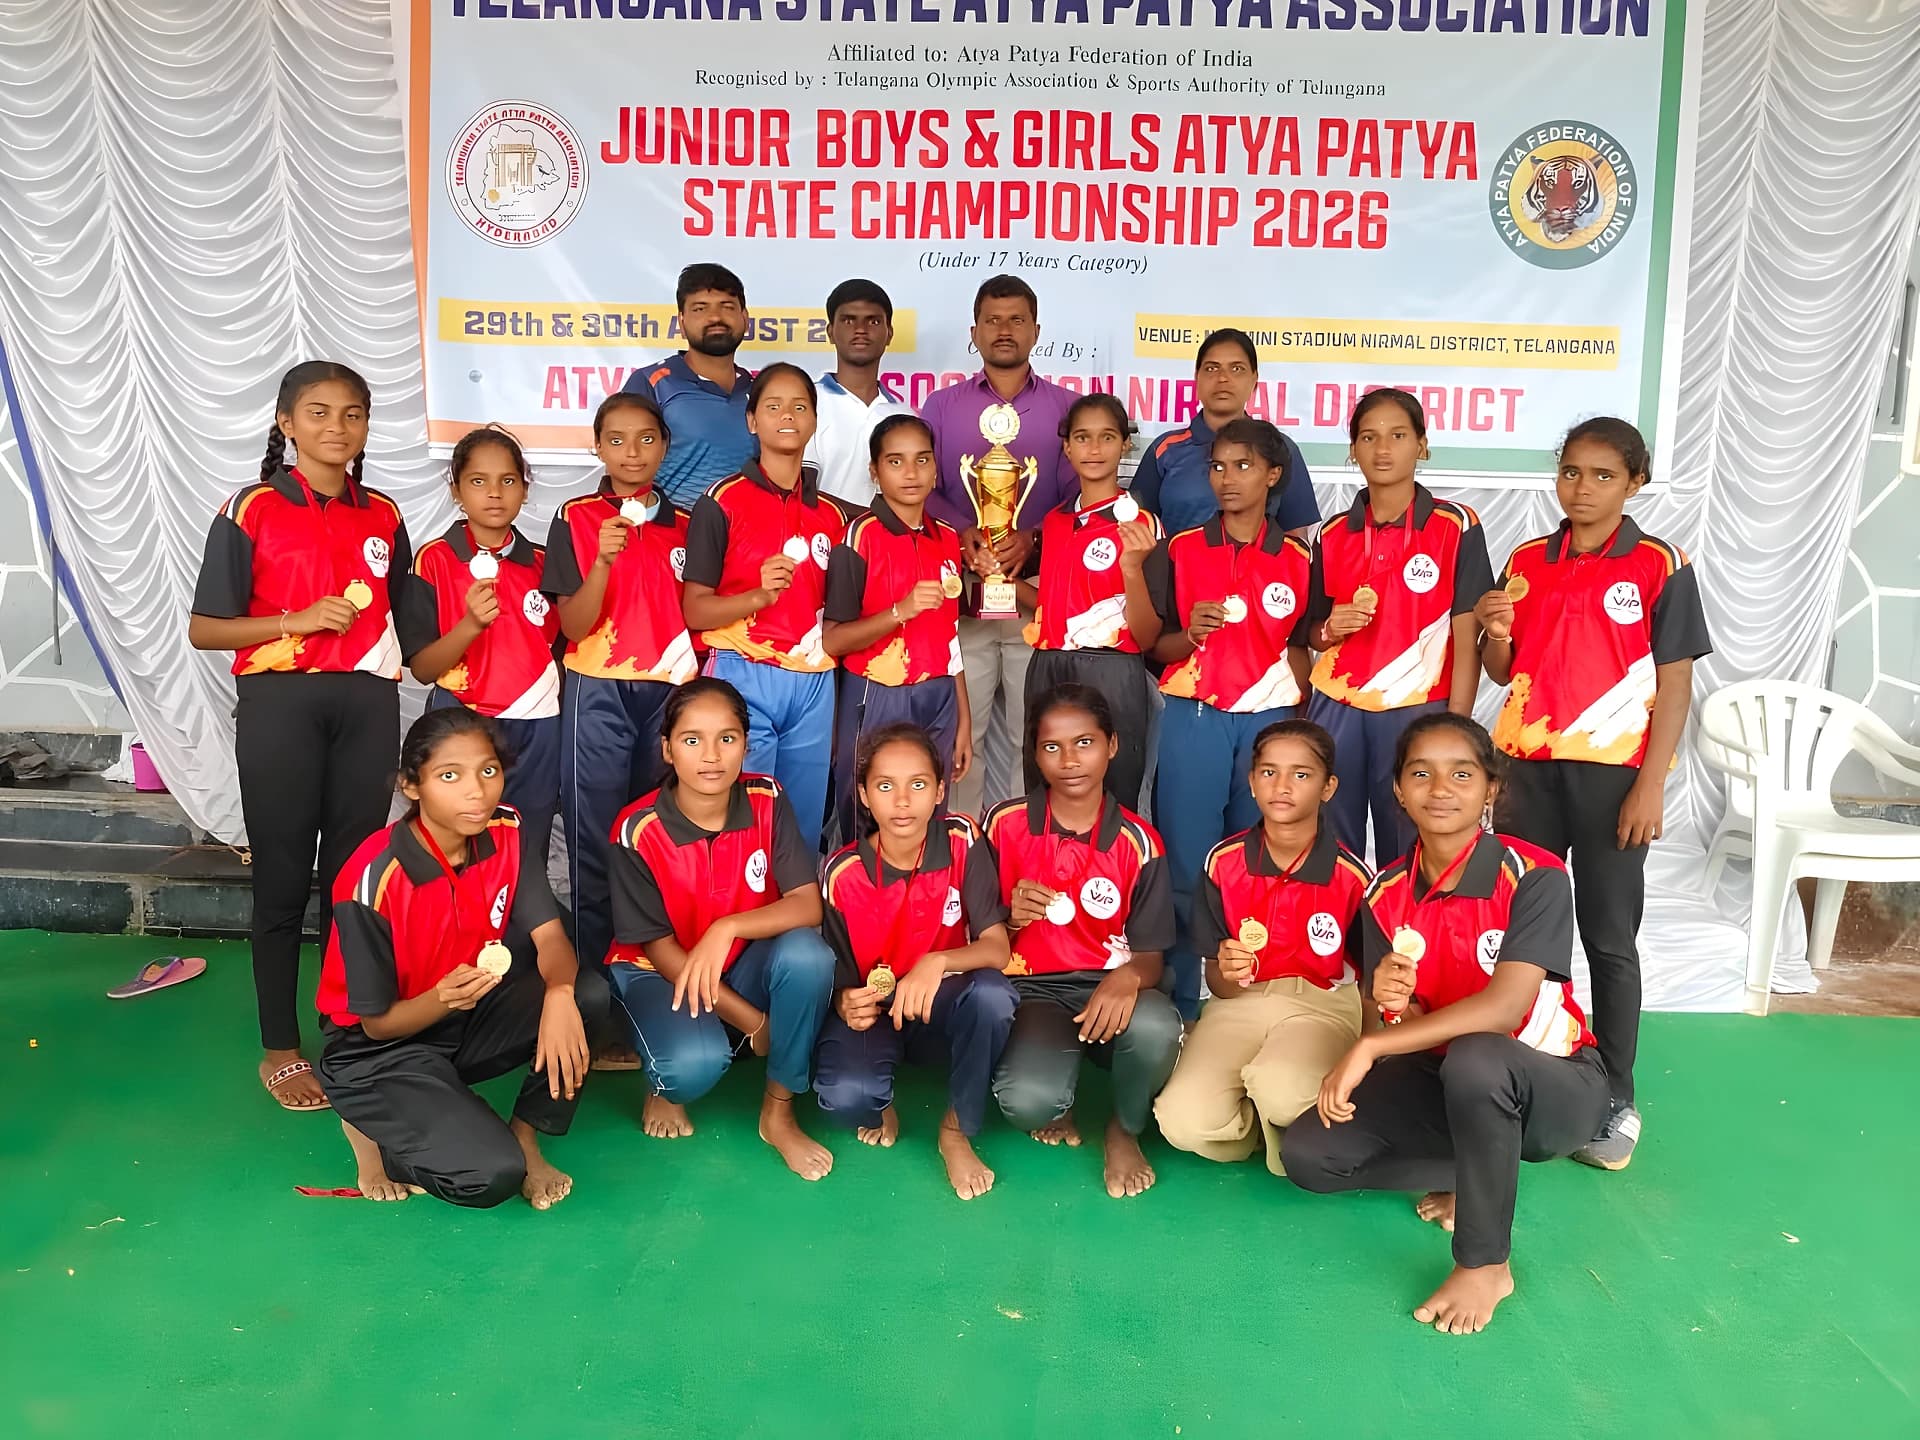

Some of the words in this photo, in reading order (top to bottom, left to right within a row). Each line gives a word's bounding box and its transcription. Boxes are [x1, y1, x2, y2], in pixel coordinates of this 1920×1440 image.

[827, 43, 915, 62] Affiliated
[957, 45, 1000, 66] Atya
[1007, 44, 1060, 67] Patya
[1067, 45, 1167, 66] Federation
[1176, 48, 1197, 67] of
[1202, 49, 1253, 68] India
[695, 69, 787, 89] Recognised
[795, 70, 814, 90] by
[833, 71, 919, 91] Telangana
[926, 71, 997, 91] Olympic
[1003, 71, 1098, 90] Association
[1105, 73, 1120, 89] &
[1127, 73, 1181, 95] Sports
[1187, 76, 1270, 97] Authority
[1276, 79, 1294, 94] of
[601, 107, 790, 168] JUNIOR
[817, 109, 948, 168] BOYS
[964, 110, 999, 168] &
[1013, 110, 1160, 172] GIRLS
[1173, 115, 1300, 175] ATYA
[1318, 118, 1477, 180] PATYA
[1525, 126, 1630, 177] FEDERATION
[1494, 146, 1528, 201] PATYA
[1618, 182, 1632, 208] OF
[684, 178, 836, 238] STATE
[852, 181, 1238, 245] CHAMPIONSHIP
[1254, 189, 1388, 249] 2026
[1496, 206, 1529, 247] ATYA
[1586, 212, 1628, 254] INDIA
[919, 252, 980, 272] (Under
[989, 252, 1008, 266] 17
[1018, 252, 1059, 269] Years
[1068, 255, 1147, 274] Category)
[464, 310, 543, 337] 29th
[552, 314, 573, 337] &
[582, 313, 659, 339] 30th
[1139, 327, 1191, 343] VENUE
[1282, 332, 1356, 347] STADIUM
[1361, 334, 1425, 349] NIRMAL
[1514, 339, 1615, 354] TELANGANA
[1062, 343, 1083, 362] By
[1128, 376, 1300, 427] NIRAL
[1314, 383, 1524, 432] DIRICT
